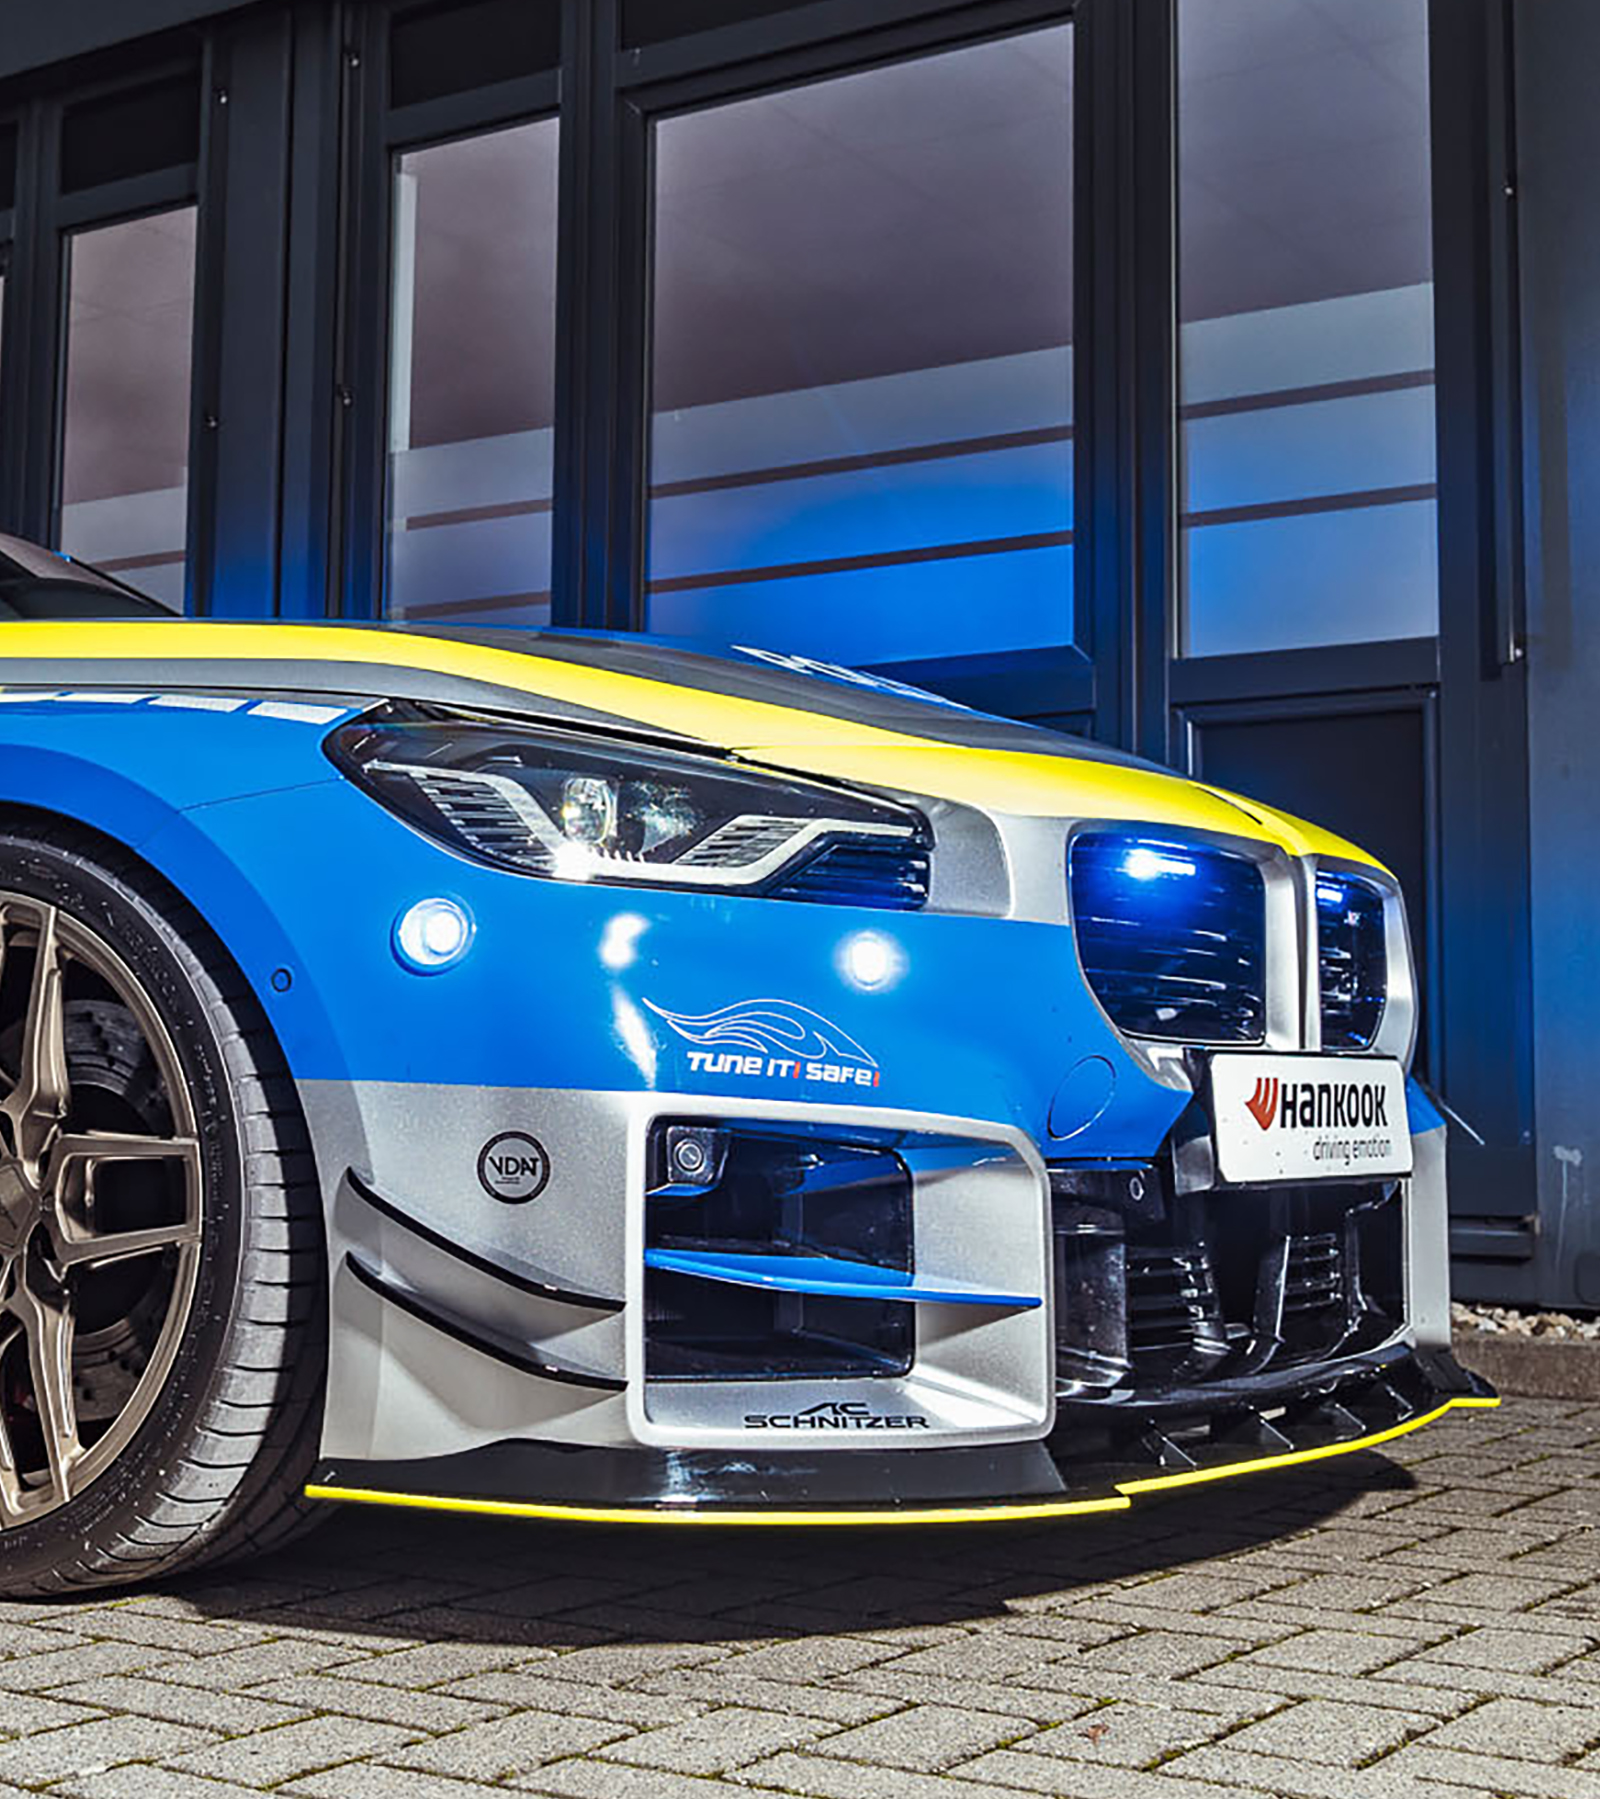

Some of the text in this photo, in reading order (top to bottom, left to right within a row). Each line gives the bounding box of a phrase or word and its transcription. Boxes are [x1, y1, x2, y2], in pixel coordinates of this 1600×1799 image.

[1312, 1134, 1350, 1166] driving
[488, 1155, 540, 1177] VDAT
[799, 1402, 870, 1416] AC
[744, 1414, 930, 1429] SCHNITZER
